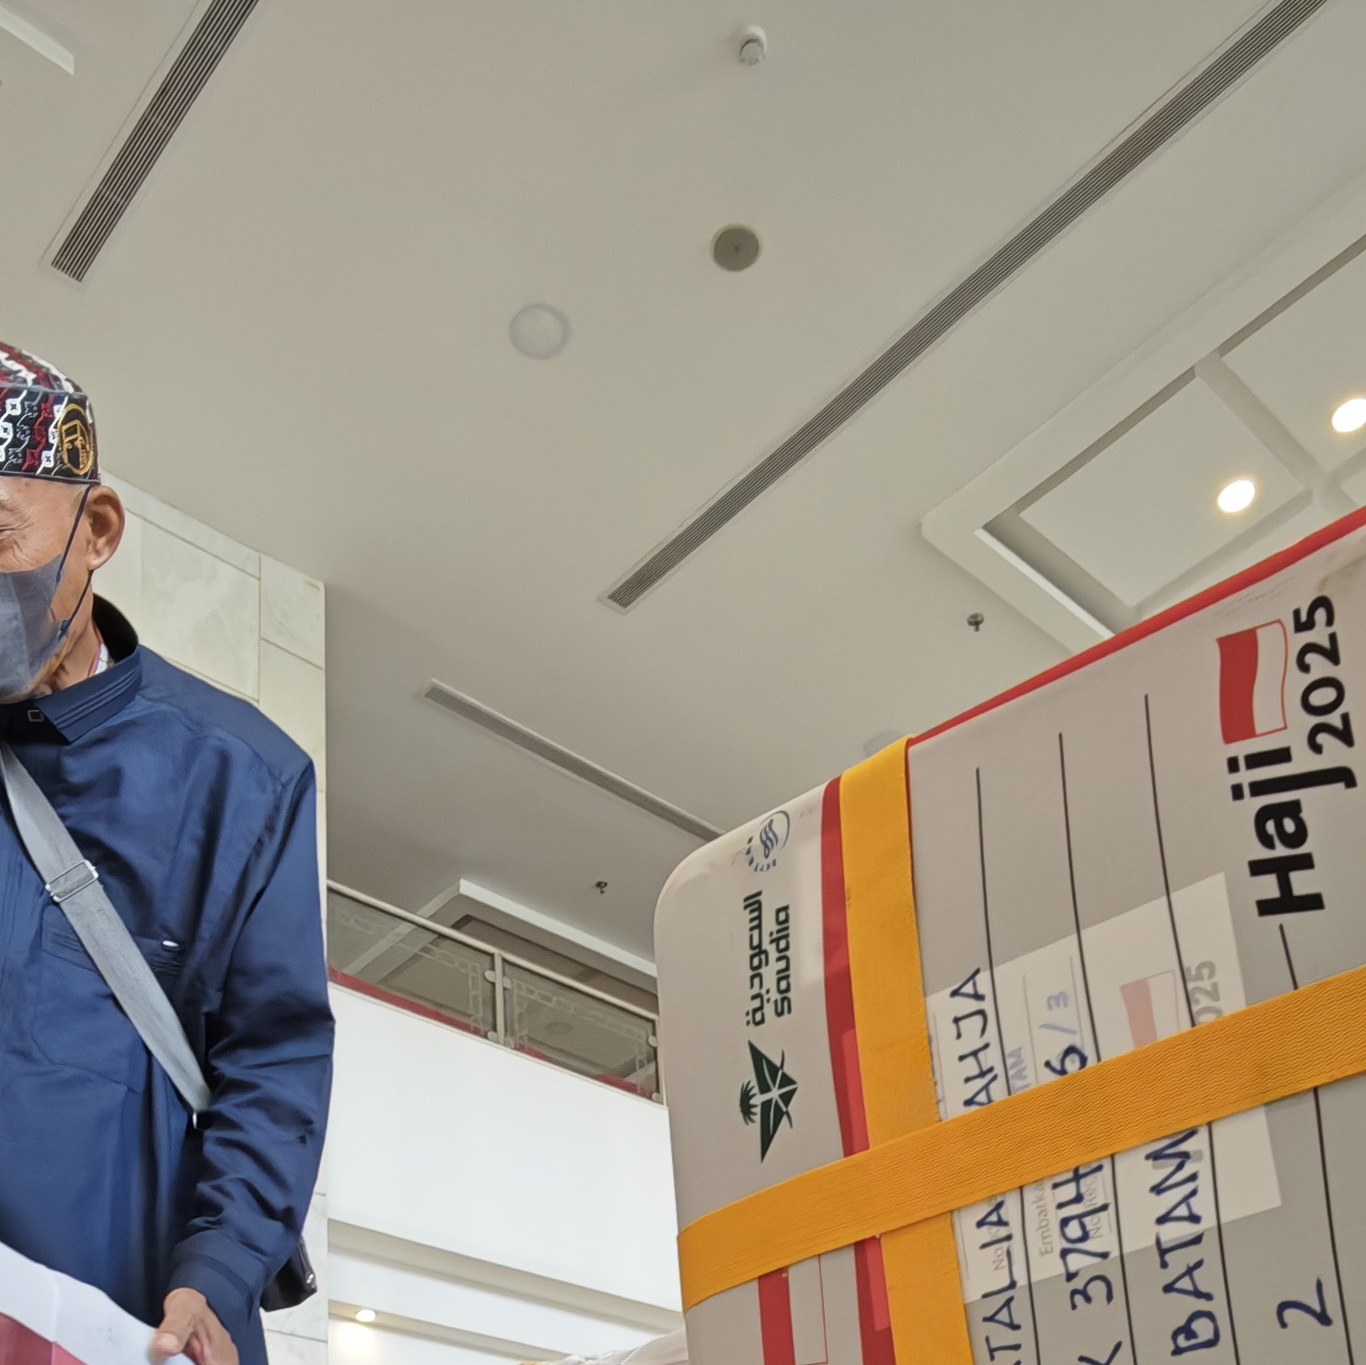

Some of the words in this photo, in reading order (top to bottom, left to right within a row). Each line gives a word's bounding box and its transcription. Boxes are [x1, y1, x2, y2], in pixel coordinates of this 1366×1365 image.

[1292, 595, 1355, 755] 2025
[1227, 746, 1357, 917] Haji
[743, 890, 772, 1028] السعودية
[769, 904, 793, 1019] Saudia
[1185, 960, 1224, 1024] 025
[949, 967, 999, 1107] AHJA
[1145, 1128, 1221, 1357] BATAM
[1276, 1275, 1333, 1329] 2
